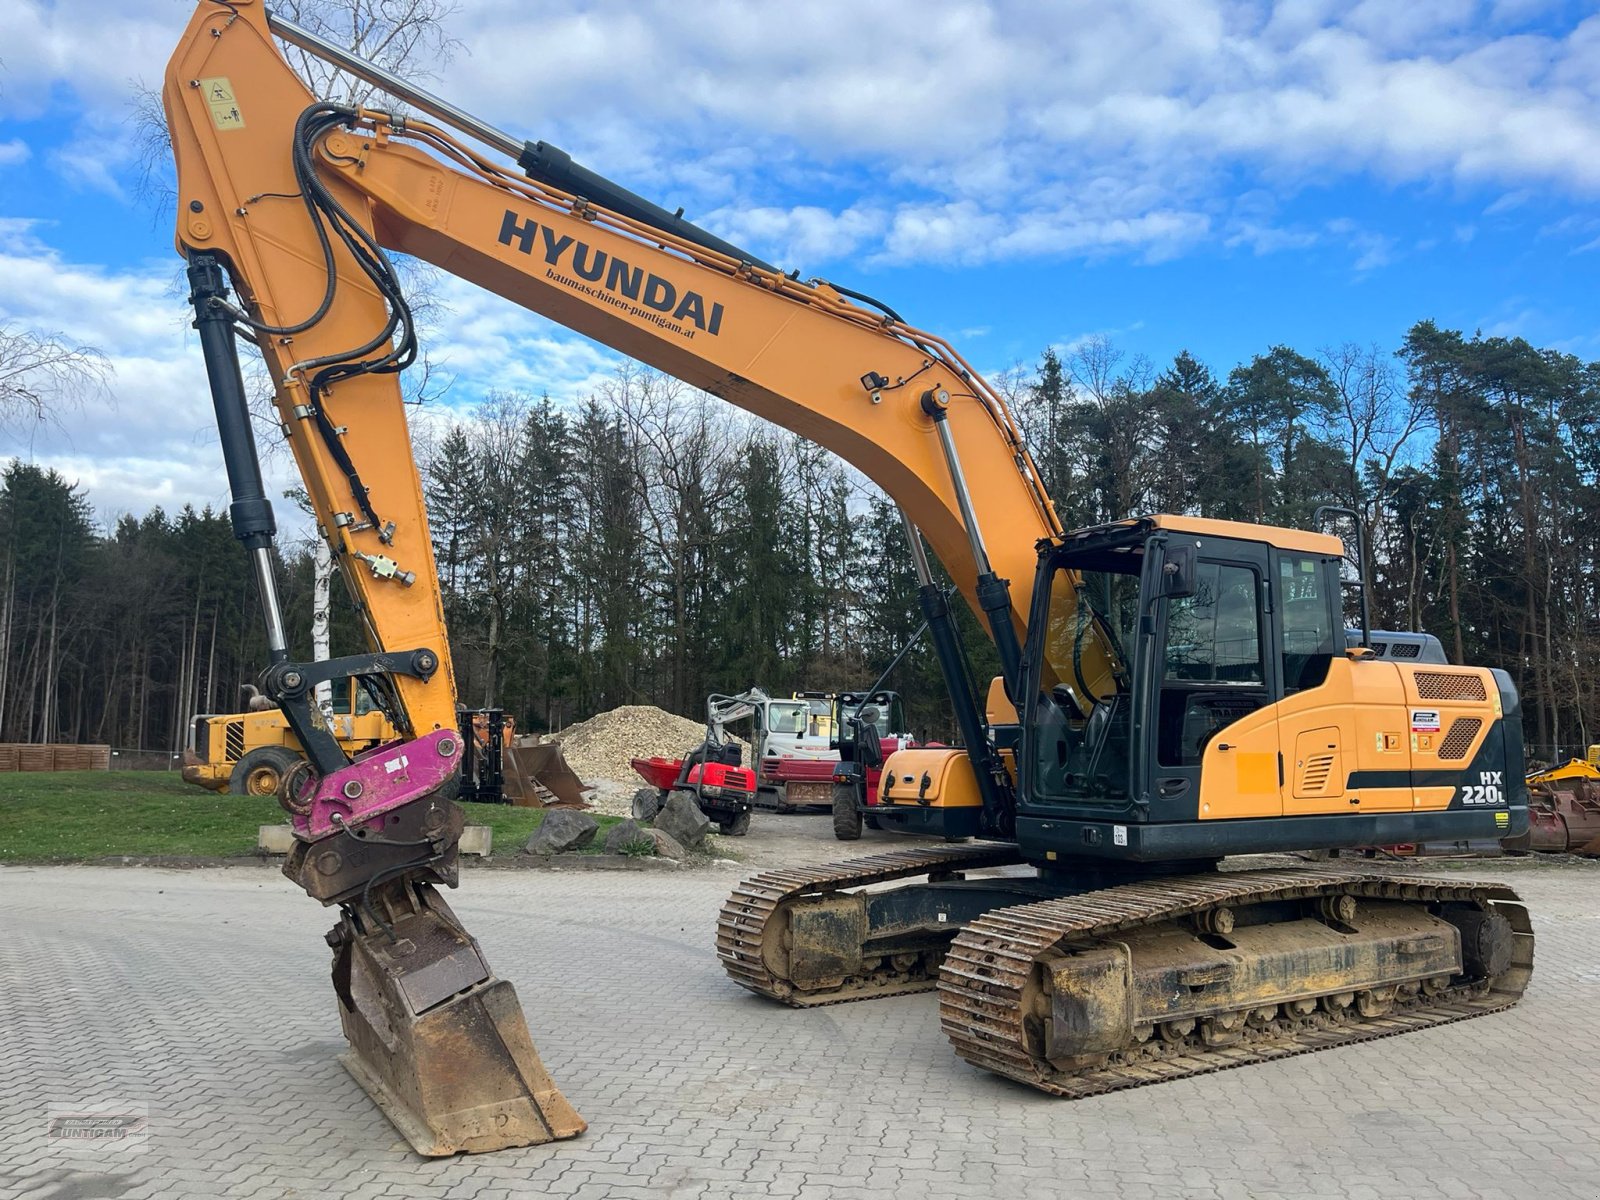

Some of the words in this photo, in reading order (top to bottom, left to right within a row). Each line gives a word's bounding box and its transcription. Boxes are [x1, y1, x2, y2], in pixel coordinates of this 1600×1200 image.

[498, 209, 724, 336] HYUNDAI
[546, 268, 696, 339] baumaschinen-puntigam.at
[1480, 771, 1502, 785] HX
